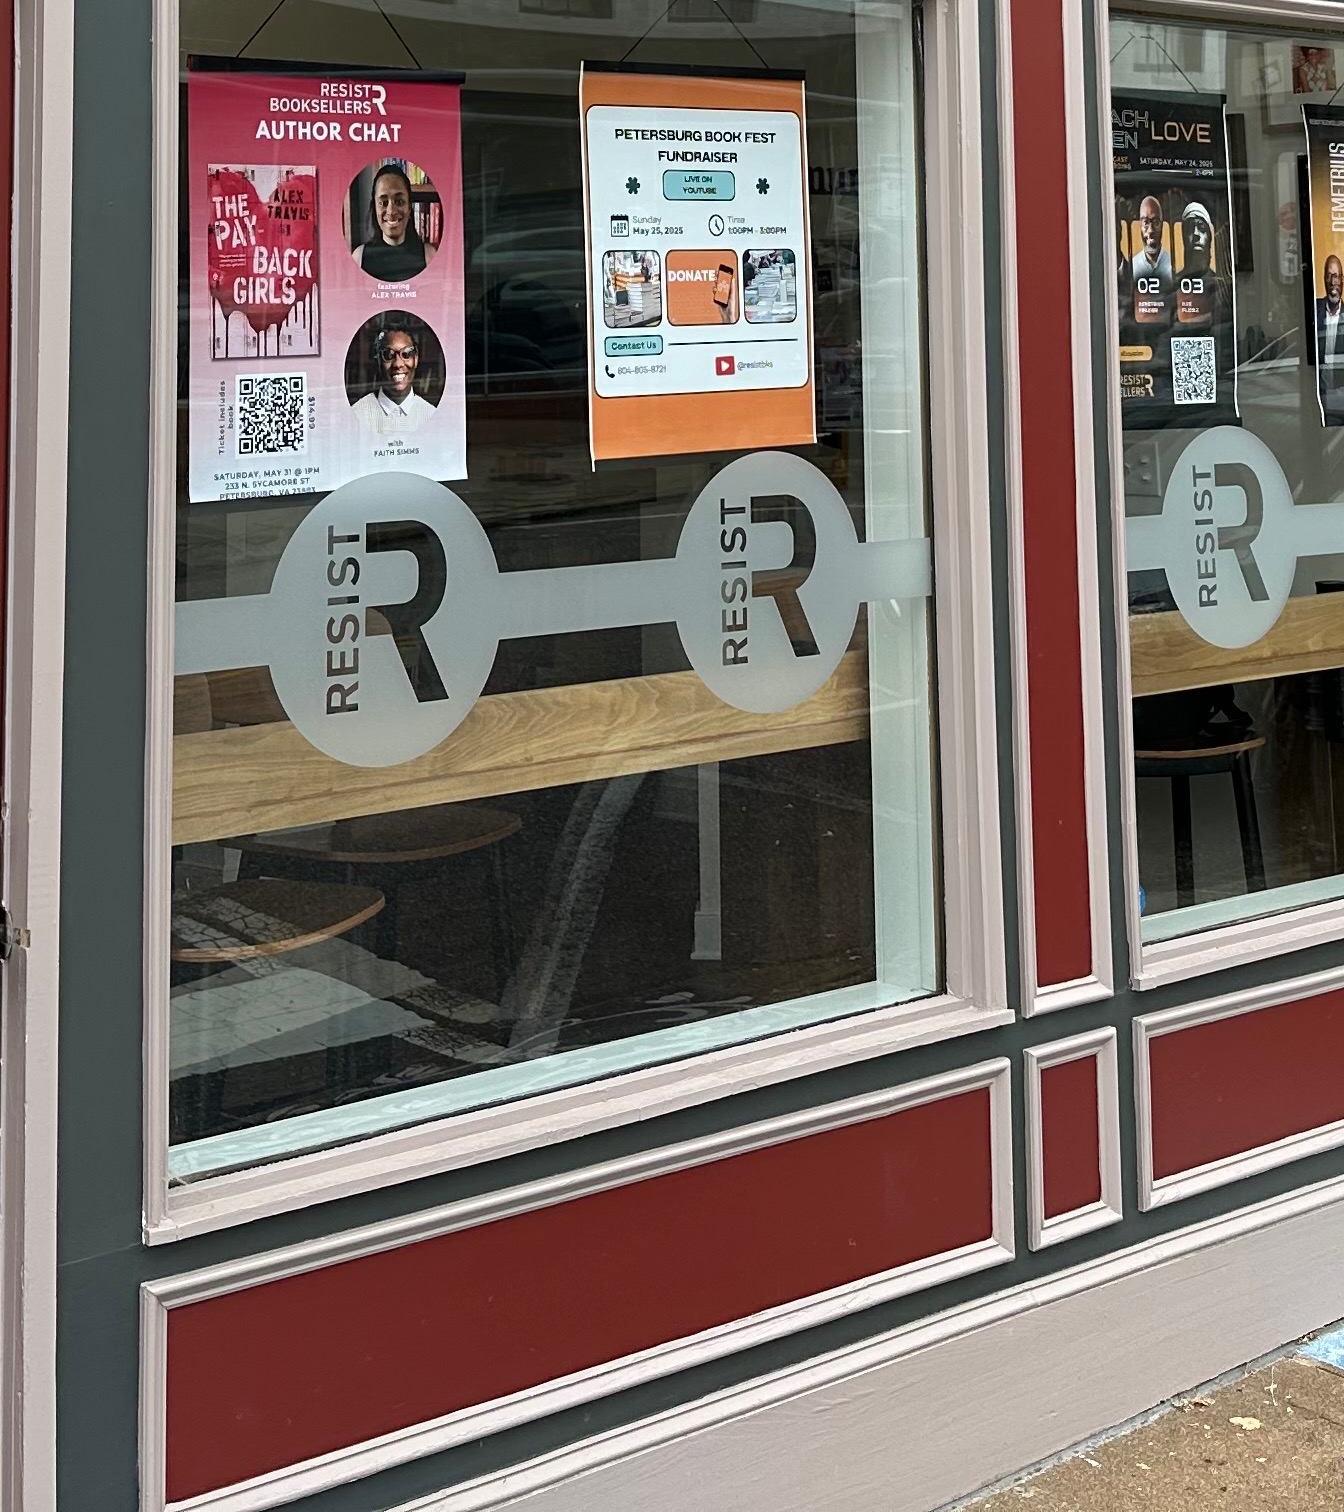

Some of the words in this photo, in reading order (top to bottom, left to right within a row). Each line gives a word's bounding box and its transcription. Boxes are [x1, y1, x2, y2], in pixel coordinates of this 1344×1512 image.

[320, 82, 372, 98] RESIST
[269, 97, 372, 115] BOOKSELLERS
[371, 85, 387, 116] R
[1111, 109, 1149, 129] ACH
[256, 120, 343, 141] AUTHOR
[348, 123, 401, 143] CHAT
[614, 128, 702, 142] PETERSBURG
[704, 131, 742, 143] BOOK
[744, 132, 776, 144] FEST
[1112, 130, 1138, 149] EN
[1150, 121, 1212, 143] LOVE
[658, 150, 738, 163] FUNDRAISER
[1139, 156, 1174, 167] SATURDAY,
[1174, 159, 1188, 167] MAY
[684, 175, 700, 183] LIVE
[701, 175, 713, 183] ON
[273, 188, 304, 204] ALEX
[682, 187, 717, 195] YOUTUBE
[212, 193, 250, 219] THE
[267, 205, 310, 221] TRAVIS
[632, 215, 662, 225] Sunday
[727, 216, 745, 224] Time
[632, 226, 649, 236] May
[651, 226, 664, 236] 25,
[665, 226, 684, 235] 2025
[253, 246, 313, 279] BACK
[667, 269, 716, 282] DONATE
[233, 276, 296, 305] GIRLS
[1137, 277, 1160, 294] 02
[1180, 277, 1204, 294] 03
[371, 291, 390, 299] ALEX
[611, 341, 645, 351] Contact
[646, 340, 657, 350] Us
[218, 380, 226, 422] includes
[374, 449, 395, 457] FAITH
[213, 470, 261, 481] SATURDAY,
[264, 469, 282, 478] MAY
[283, 468, 292, 476] 31
[252, 478, 293, 488] SYCAMORE
[299, 477, 310, 485] ST
[1191, 464, 1219, 608] RESIST
[1213, 461, 1270, 602] R
[719, 497, 749, 667] RESIST
[749, 493, 822, 659] R
[325, 524, 361, 715] RESIST
[364, 519, 450, 704] R
